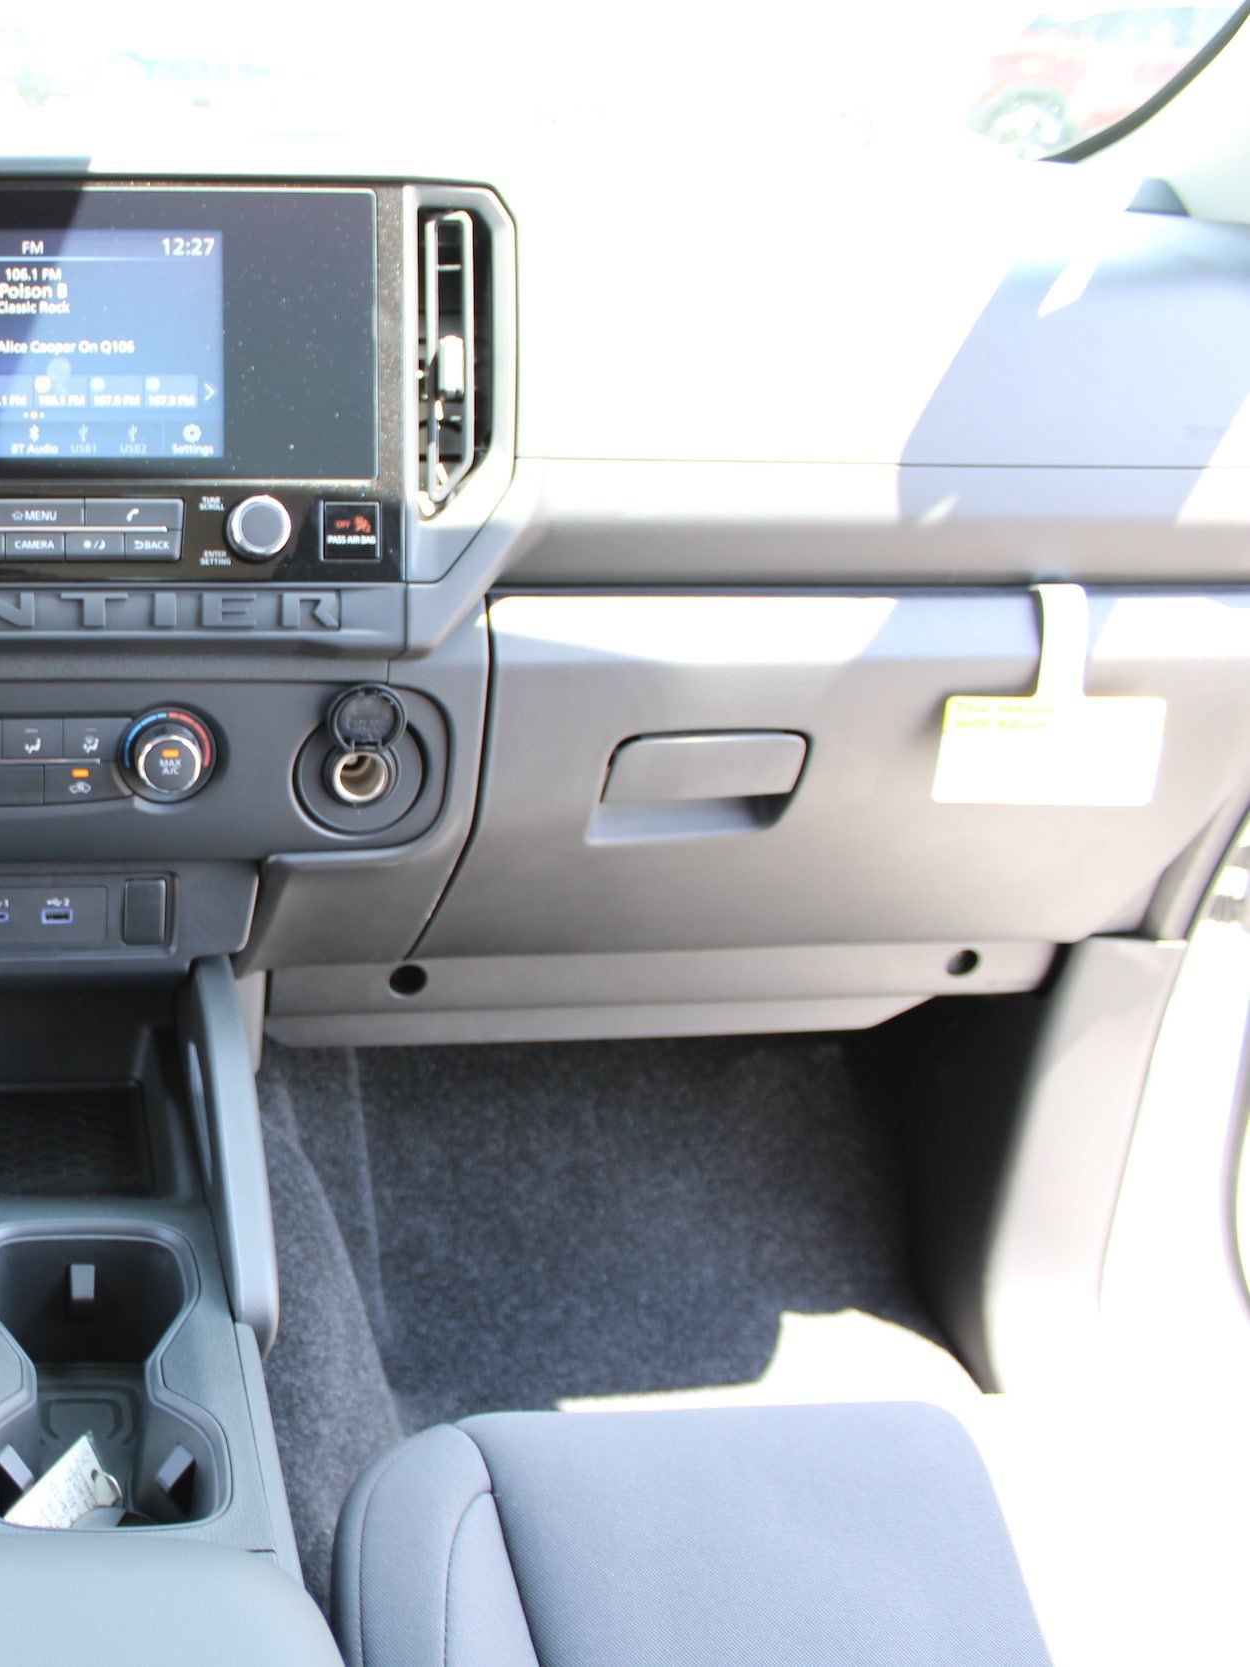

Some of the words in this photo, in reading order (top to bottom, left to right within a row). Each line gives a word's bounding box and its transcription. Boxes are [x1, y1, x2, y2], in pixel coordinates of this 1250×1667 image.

[21, 240, 44, 255] FM
[162, 237, 215, 256] 12:27
[5, 267, 37, 281] 106.1
[42, 267, 62, 281] FM
[57, 283, 68, 299] B
[40, 301, 70, 315] Rock
[29, 339, 76, 357] Cooper
[78, 339, 98, 354] On
[100, 339, 135, 356] Q106
[9, 395, 27, 407] FM
[67, 394, 86, 407] FM
[123, 394, 141, 407] FM
[177, 394, 196, 407] FM
[11, 443, 25, 455] BT
[27, 443, 59, 455] Audio
[71, 444, 97, 455] USB1
[120, 444, 147, 455] USB2
[171, 443, 214, 457] Settings
[202, 496, 222, 504] TUNE
[199, 503, 225, 511] SCROLL
[24, 510, 57, 521] MENU
[335, 519, 351, 529] OFF
[327, 534, 346, 545] PASS
[347, 535, 360, 545] AIR
[361, 535, 377, 545] BAG
[14, 541, 55, 550] CAMERA
[145, 541, 170, 550] BACK
[204, 550, 227, 558] ENTER
[200, 558, 232, 566] SETTING
[159, 759, 182, 768] MAX
[162, 767, 180, 776] A/C
[63, 898, 71, 908] 2
